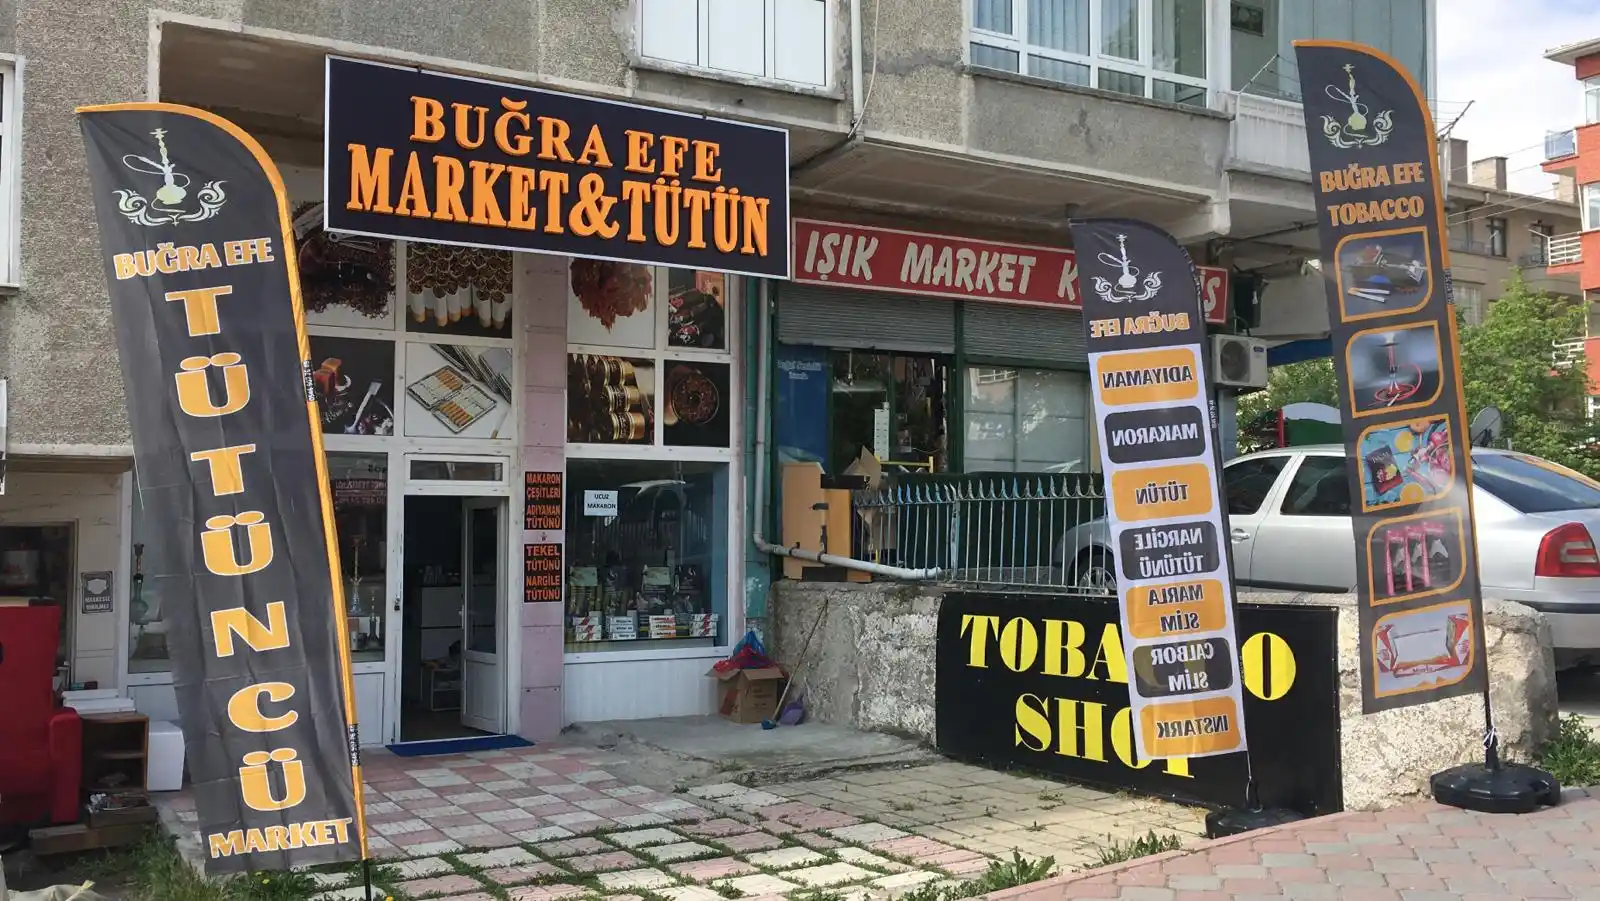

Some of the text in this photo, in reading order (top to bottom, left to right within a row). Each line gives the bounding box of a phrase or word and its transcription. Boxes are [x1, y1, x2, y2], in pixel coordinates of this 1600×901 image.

[410, 96, 723, 183] BUĞRA EFE
[1319, 161, 1425, 193] BUĞRA EFE
[346, 143, 770, 257] MARKET&TÜTÜN
[1326, 196, 1424, 226] TOBACCO
[113, 237, 274, 280] BUĞRA EFE
[803, 230, 879, 281] IŞIK
[900, 241, 1037, 296] MARKET
[526, 473, 560, 484] MAKARON
[527, 504, 560, 515] ADIYAMAN
[527, 516, 560, 529] TÜTÜNÜ
[165, 285, 306, 811] TÜTÜNCÜ
[526, 546, 560, 557] TEKEL
[526, 558, 560, 571] TÜTÜNÜ
[526, 573, 560, 586] NARGİLE
[526, 588, 560, 601] TÜTÜNÜ
[960, 614, 1296, 701] TOBAO
[1015, 693, 1195, 778] SHO
[209, 817, 352, 859] MARKET
